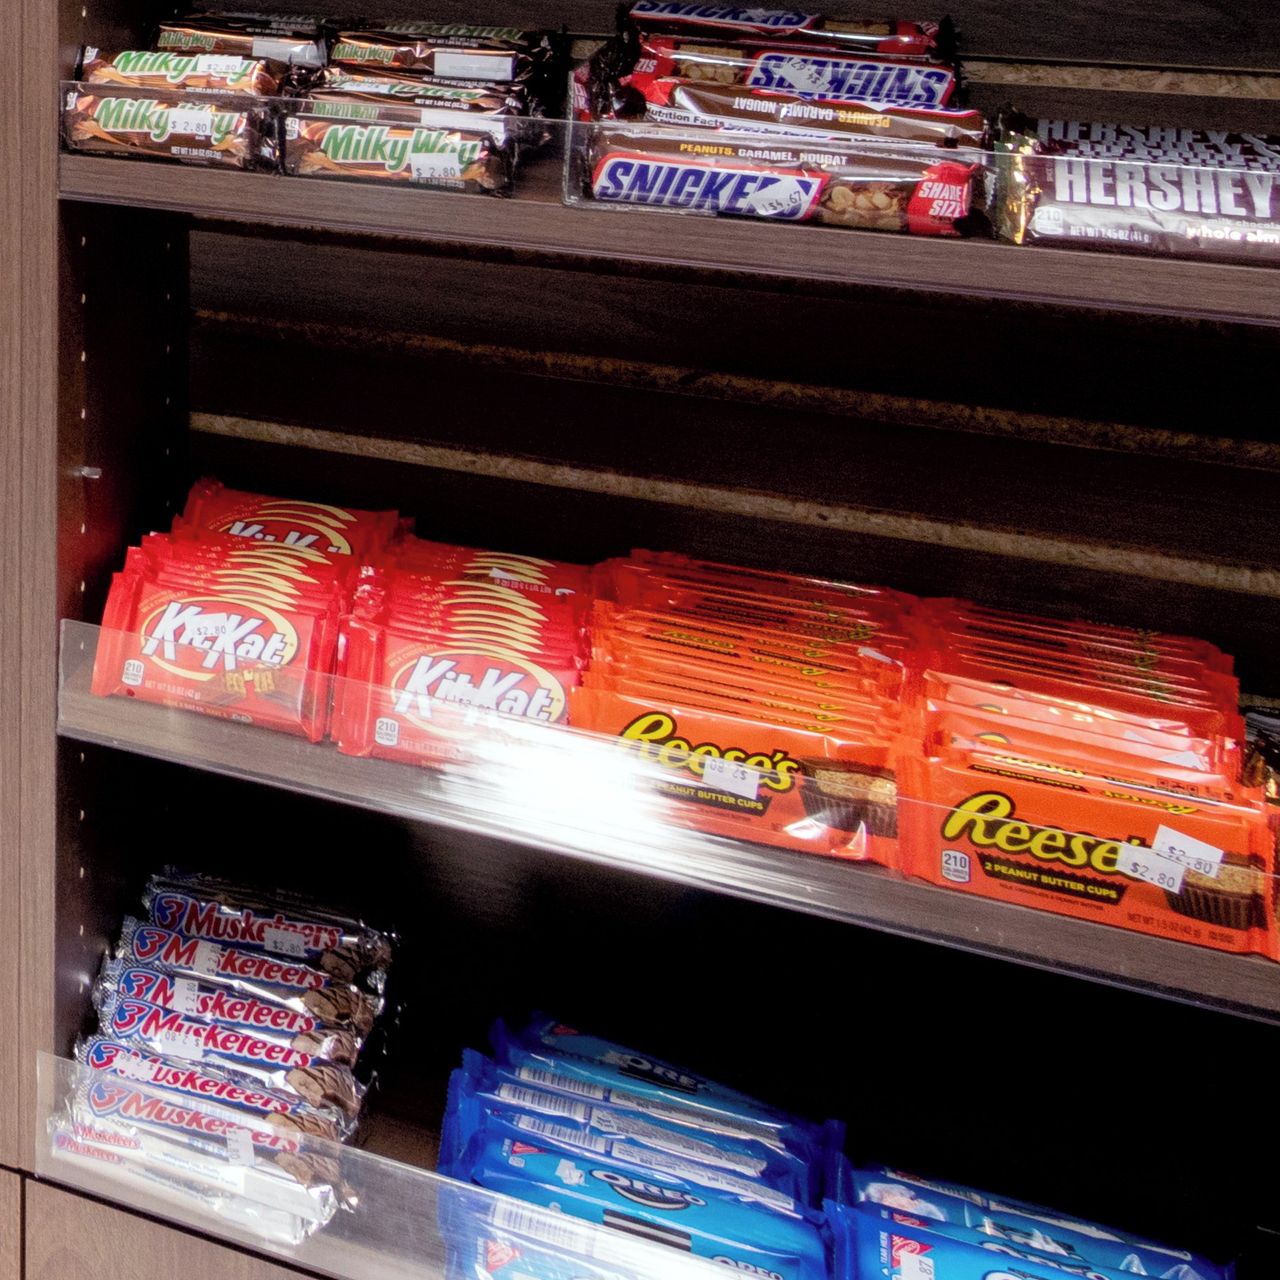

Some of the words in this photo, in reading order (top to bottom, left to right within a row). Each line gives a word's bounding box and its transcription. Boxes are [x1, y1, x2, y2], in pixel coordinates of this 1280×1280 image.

[918, 181, 963, 199] SHARE
[196, 625, 226, 636] $2.80
[126, 662, 141, 674] 210
[377, 719, 396, 733] 210
[698, 790, 736, 805] BUTTER
[737, 798, 763, 810] CUPS
[944, 853, 968, 868] 210
[994, 864, 1037, 881] PEANUT
[1041, 874, 1084, 892] BUTTER
[1087, 884, 1117, 899] CUPS
[1130, 862, 1176, 888] $2.80
[161, 898, 186, 930] 3
[590, 1170, 707, 1206] OREO
